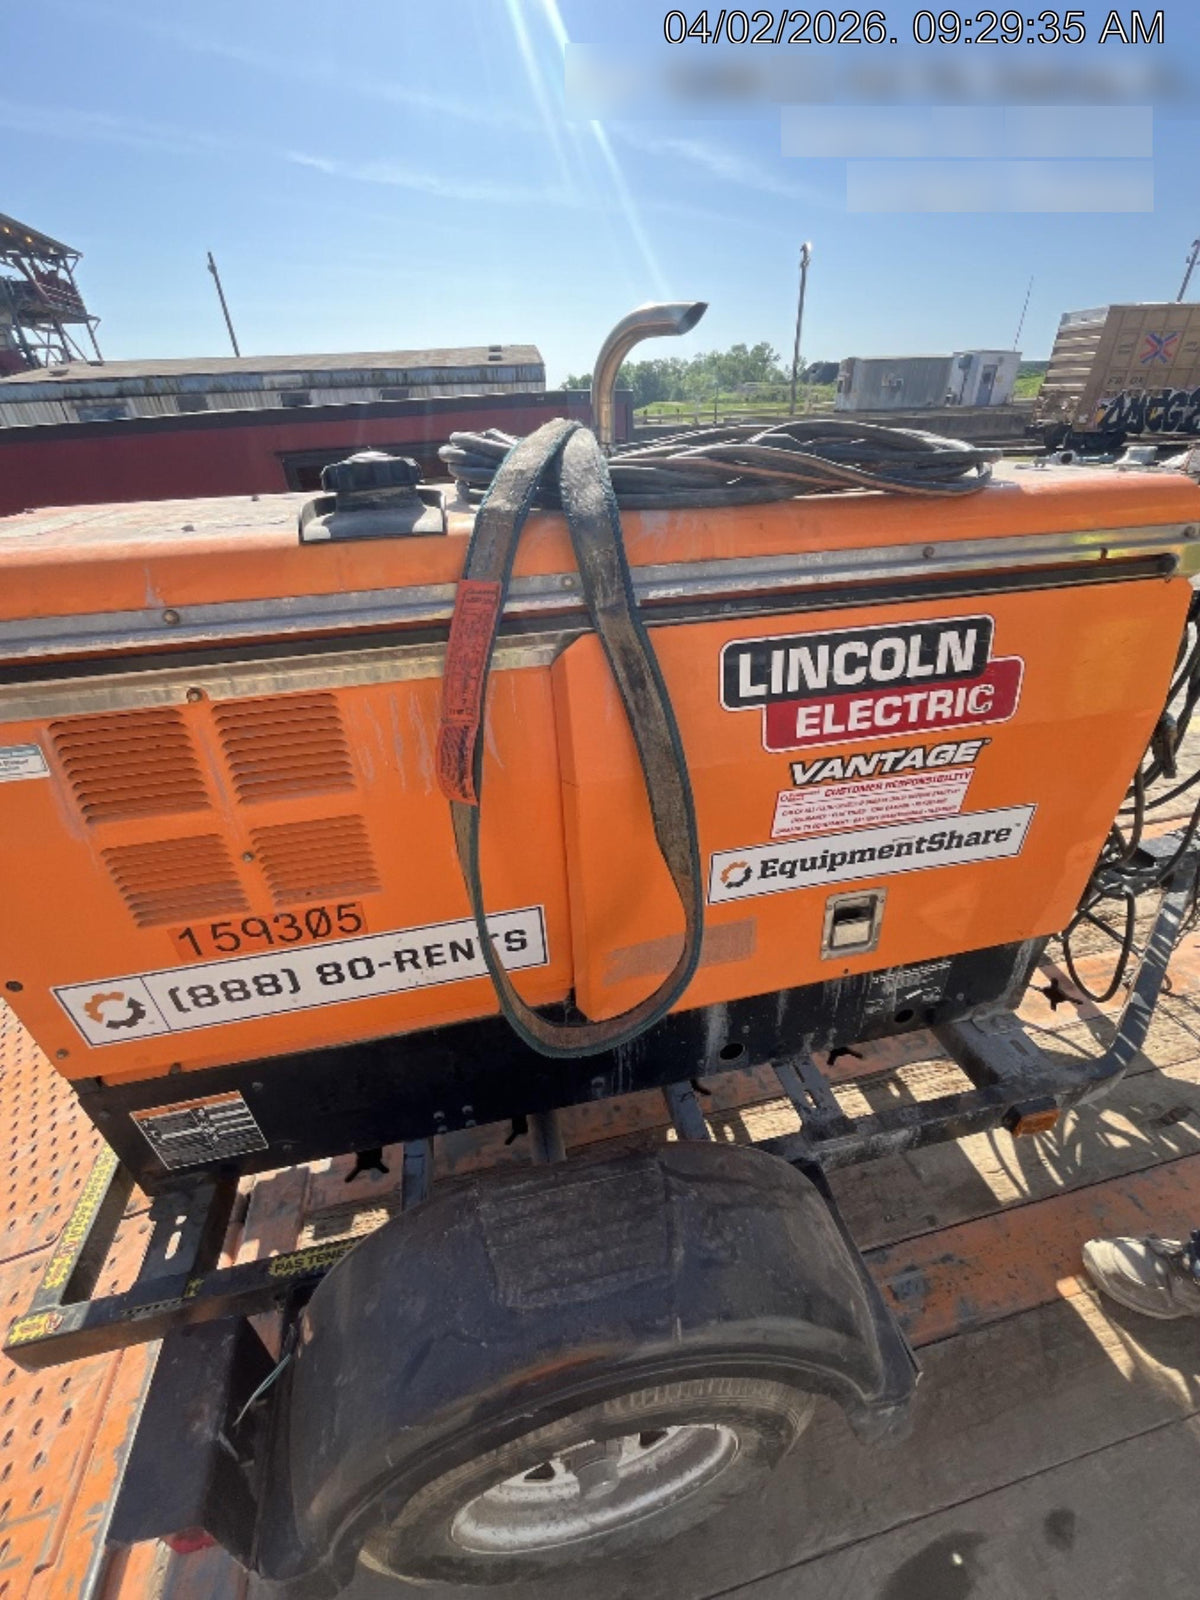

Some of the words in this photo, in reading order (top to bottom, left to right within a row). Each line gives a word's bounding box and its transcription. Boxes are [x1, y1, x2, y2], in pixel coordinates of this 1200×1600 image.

[738, 628, 978, 698] LINCOLN
[795, 684, 995, 738] ELECTRIC
[789, 738, 986, 786] VANTAGE
[757, 826, 1013, 881] EquipmentShare
[177, 902, 363, 957] 159305
[168, 967, 302, 1014] (888)
[315, 929, 528, 987] 80-RENS
